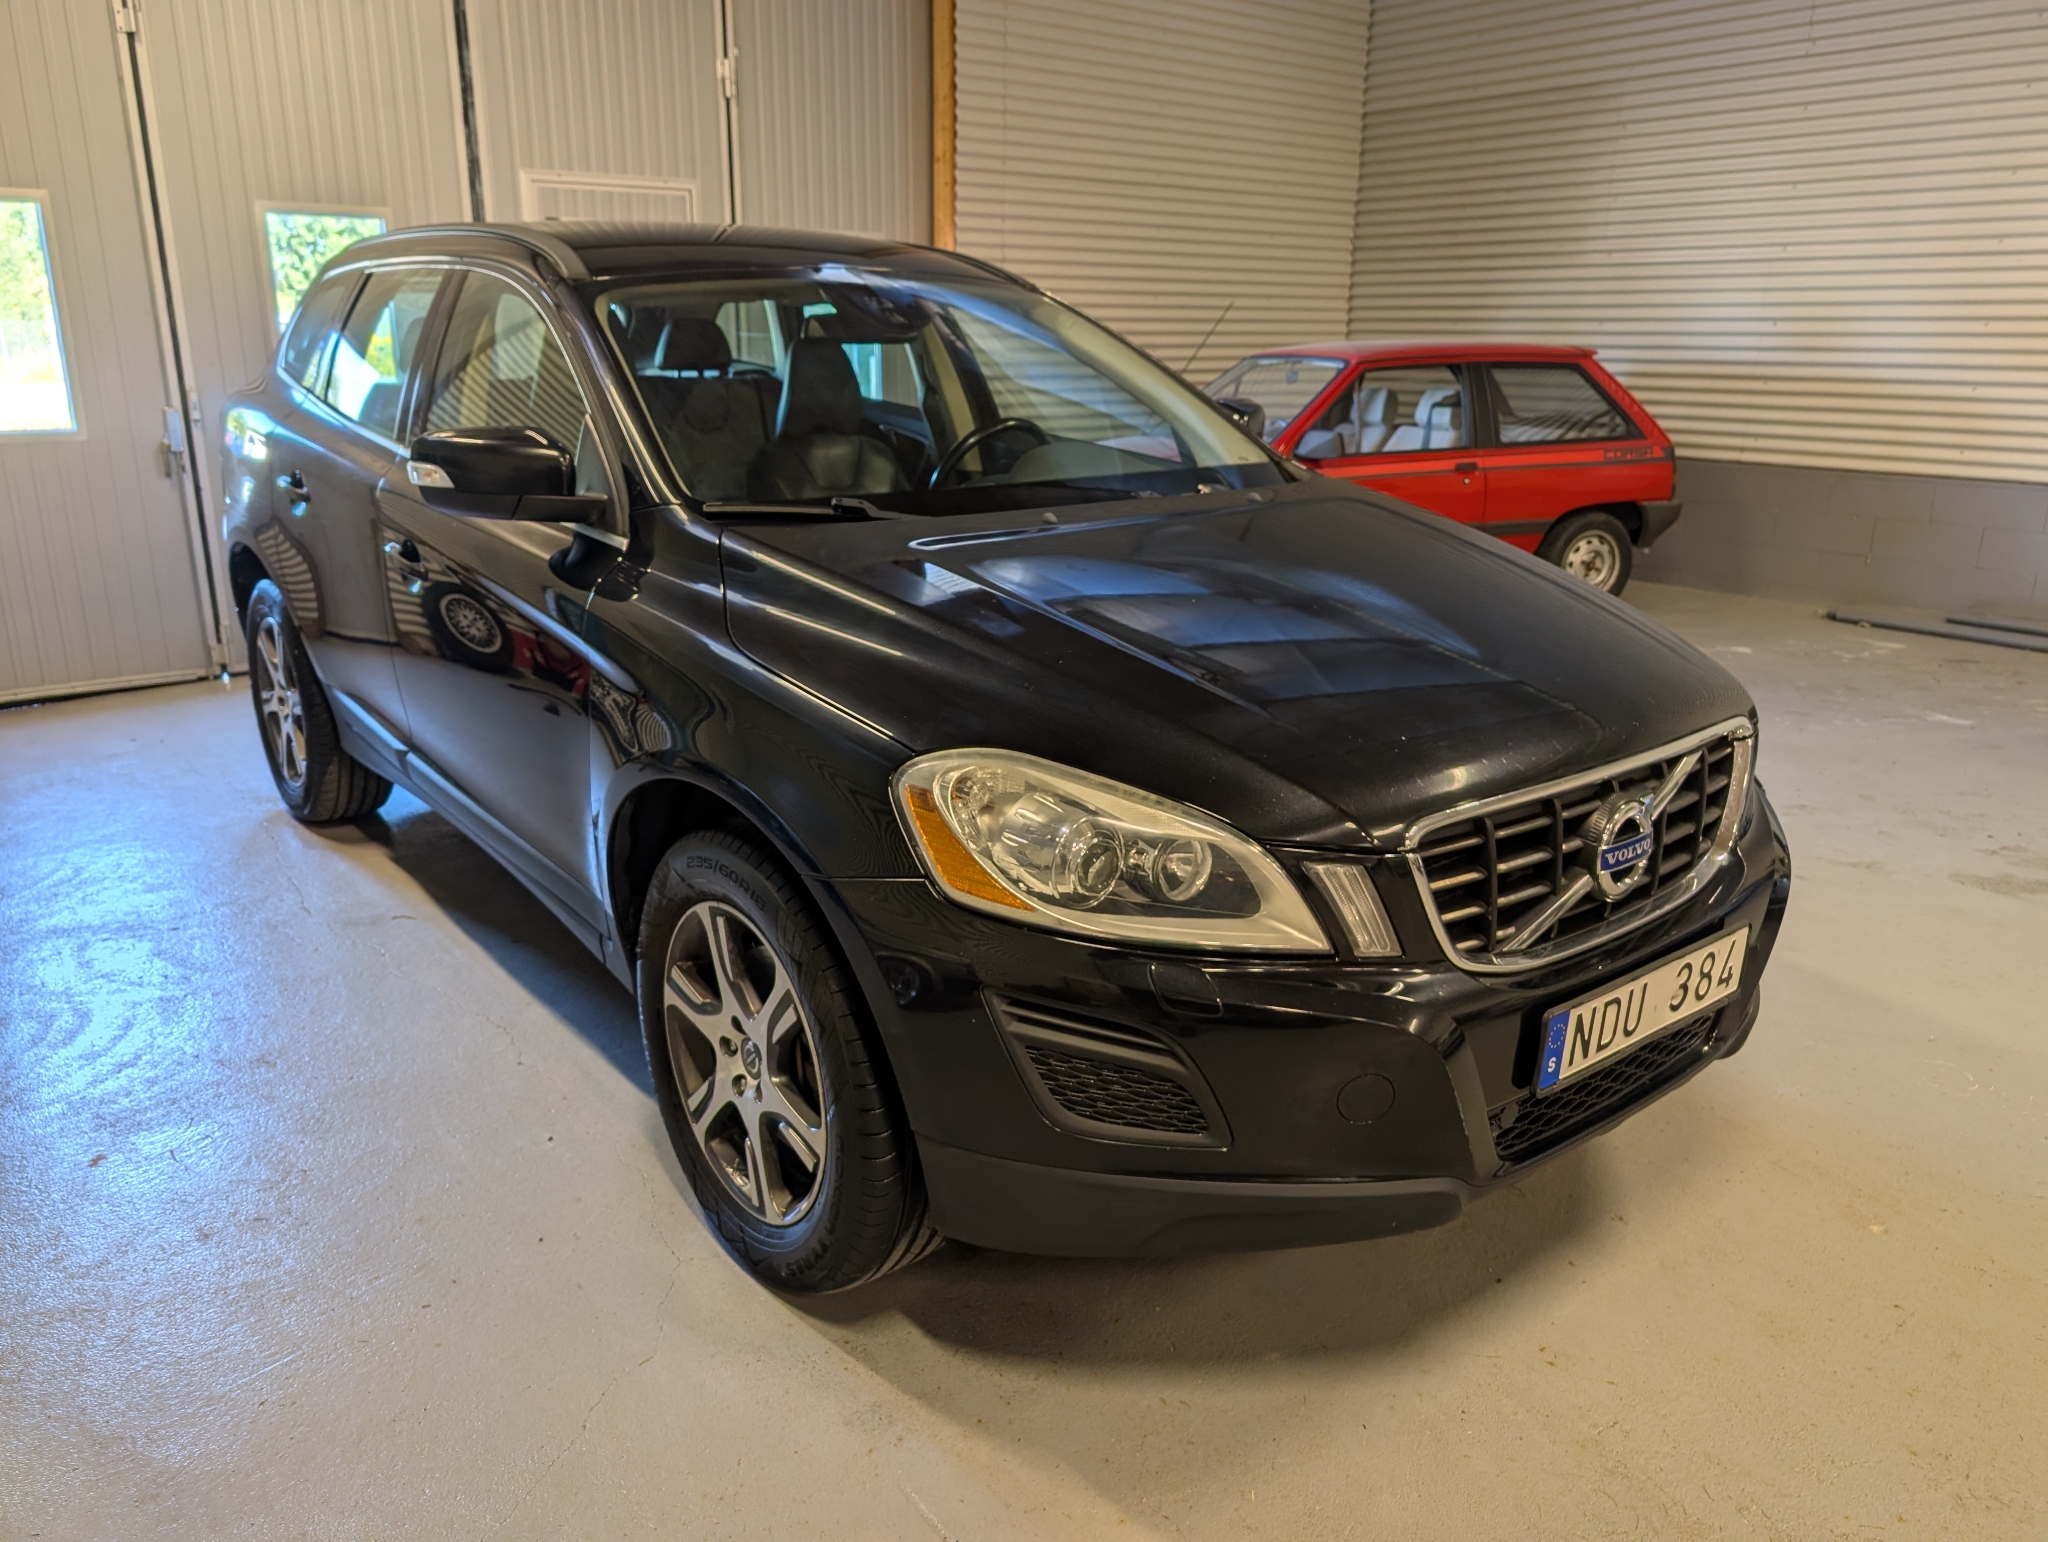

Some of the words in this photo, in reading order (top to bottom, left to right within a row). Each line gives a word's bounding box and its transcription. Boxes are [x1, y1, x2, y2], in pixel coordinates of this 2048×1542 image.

[1605, 838, 1651, 865] VOLVO
[686, 855, 766, 912] 235/60R18
[1567, 981, 1648, 1068] NDU
[1668, 939, 1737, 1012] 384
[1547, 1056, 1557, 1073] S
